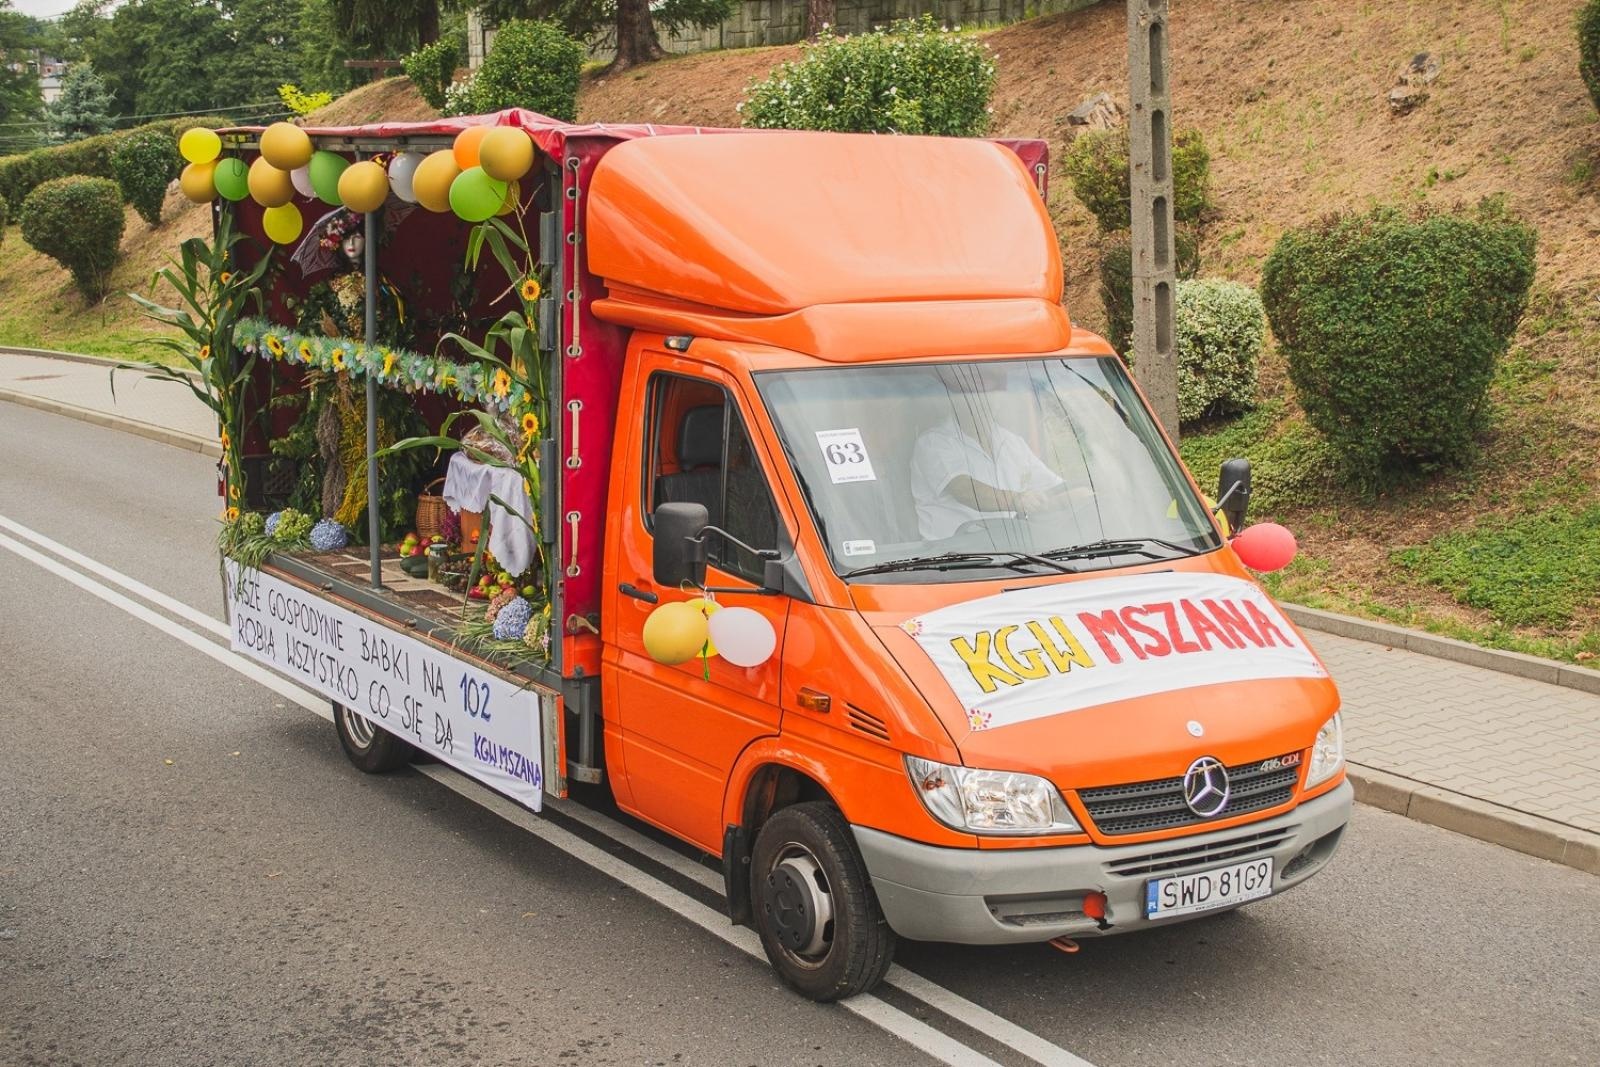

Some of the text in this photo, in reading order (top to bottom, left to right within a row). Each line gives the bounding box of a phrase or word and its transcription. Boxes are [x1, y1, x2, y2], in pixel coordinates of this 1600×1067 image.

[825, 442, 865, 465] 63
[268, 588, 344, 651] GOSPODYNIE
[359, 628, 410, 685] BABKI
[422, 658, 447, 703] NA
[460, 671, 492, 722] 102
[950, 598, 1294, 694] KGW MSZANA
[286, 633, 359, 701] WSZYSTKO
[369, 680, 391, 719] CO
[401, 694, 423, 743] SIĘ
[473, 731, 542, 790] KGW MSZANA
[1281, 752, 1299, 766] CDI
[1148, 901, 1157, 910] PL
[1163, 875, 1212, 908] SWD
[1220, 862, 1268, 897] 81G9
